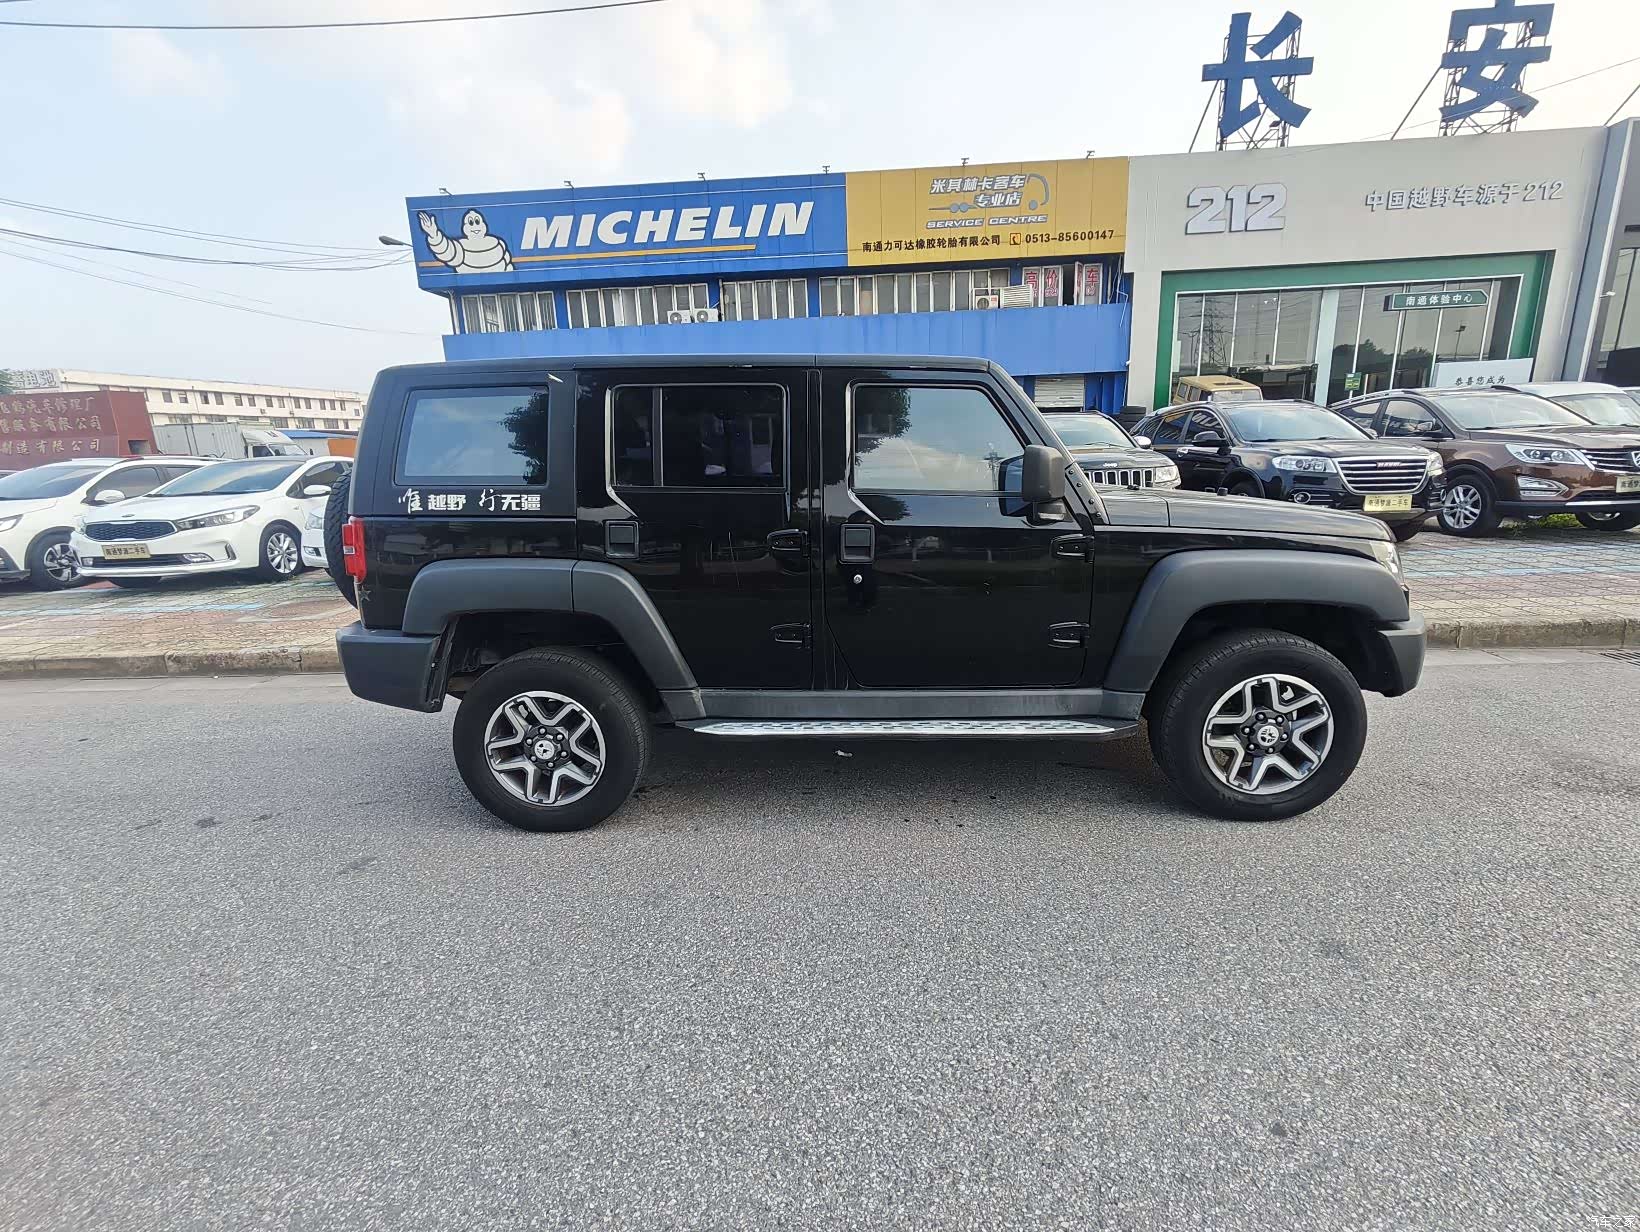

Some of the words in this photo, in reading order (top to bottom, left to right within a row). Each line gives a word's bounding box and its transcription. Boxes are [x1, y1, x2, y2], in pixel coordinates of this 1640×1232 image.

[930, 173, 1026, 195] 米其林卡客车
[974, 191, 1023, 208] 专业店
[1185, 182, 1288, 236] 212
[520, 201, 814, 251] MICHELIN
[926, 217, 985, 230] SERVICE
[988, 213, 1049, 227] CENTRE
[862, 234, 1001, 253] 南通力可达橡胶轮胎有限公司
[1025, 230, 1115, 244] 0513-85600147
[1405, 293, 1473, 307] 南通体验中心
[1455, 375, 1505, 386] 恭喜您成为
[398, 488, 467, 514] 唯越野
[478, 488, 542, 512] 行无疆
